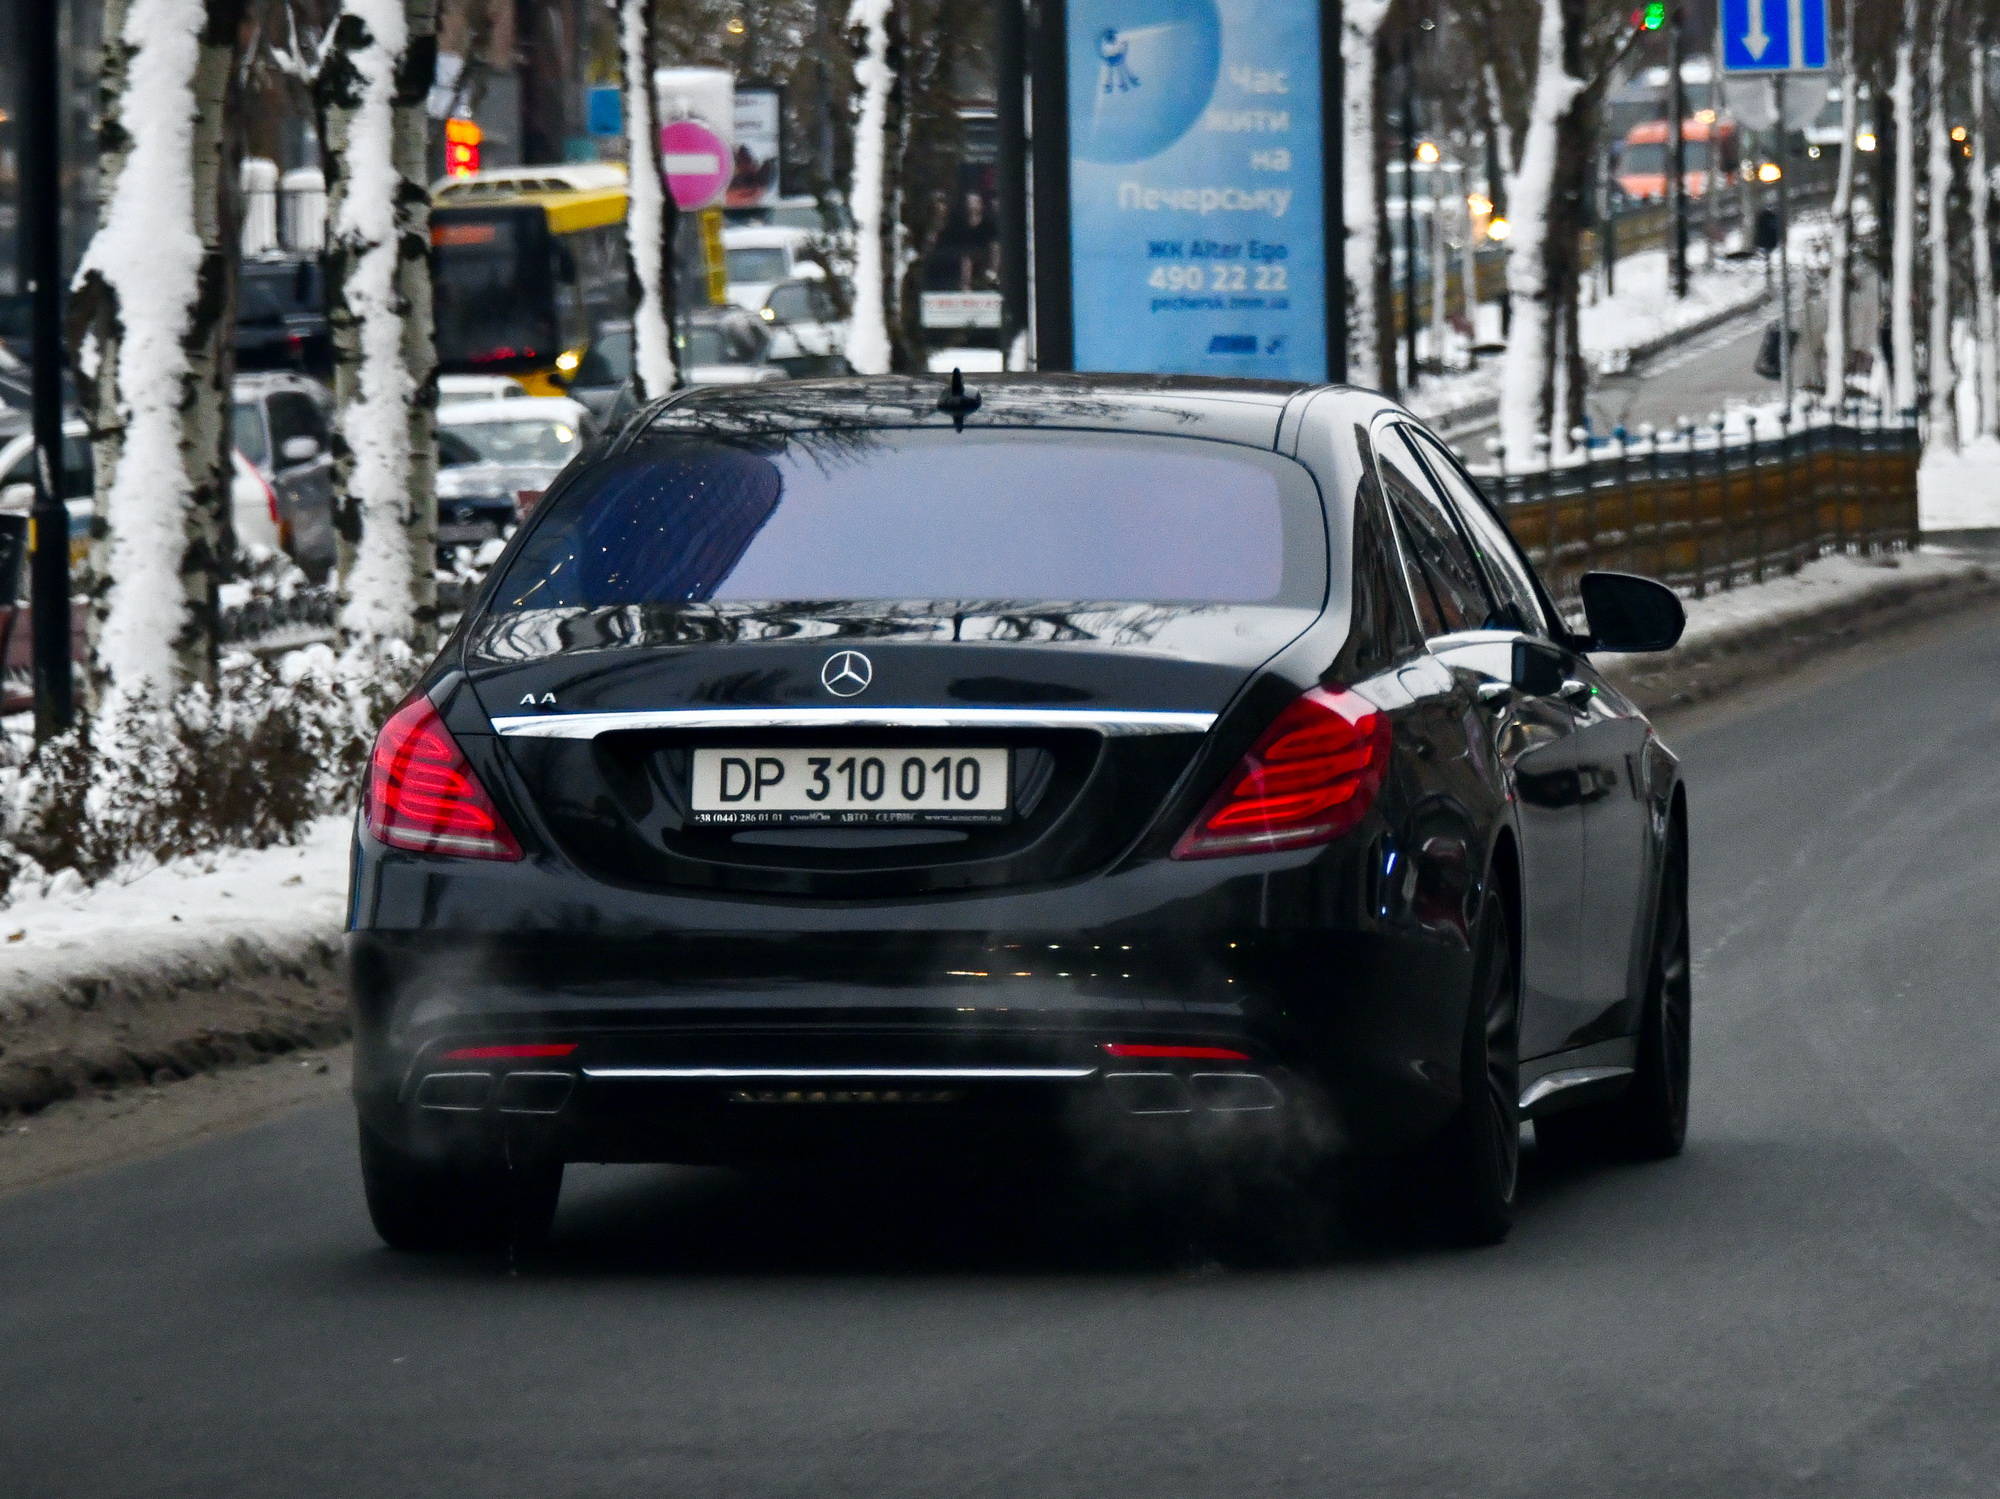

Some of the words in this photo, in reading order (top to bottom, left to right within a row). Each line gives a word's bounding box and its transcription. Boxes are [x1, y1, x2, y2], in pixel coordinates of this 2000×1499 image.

[1149, 265, 1204, 291] 490
[1212, 265, 1247, 291] 22
[1254, 265, 1288, 291] 22
[720, 757, 785, 802] DP
[806, 757, 886, 802] 310
[902, 757, 981, 802] 010
[694, 813, 711, 823] +38
[713, 813, 737, 823] (044)
[739, 813, 756, 823] 286
